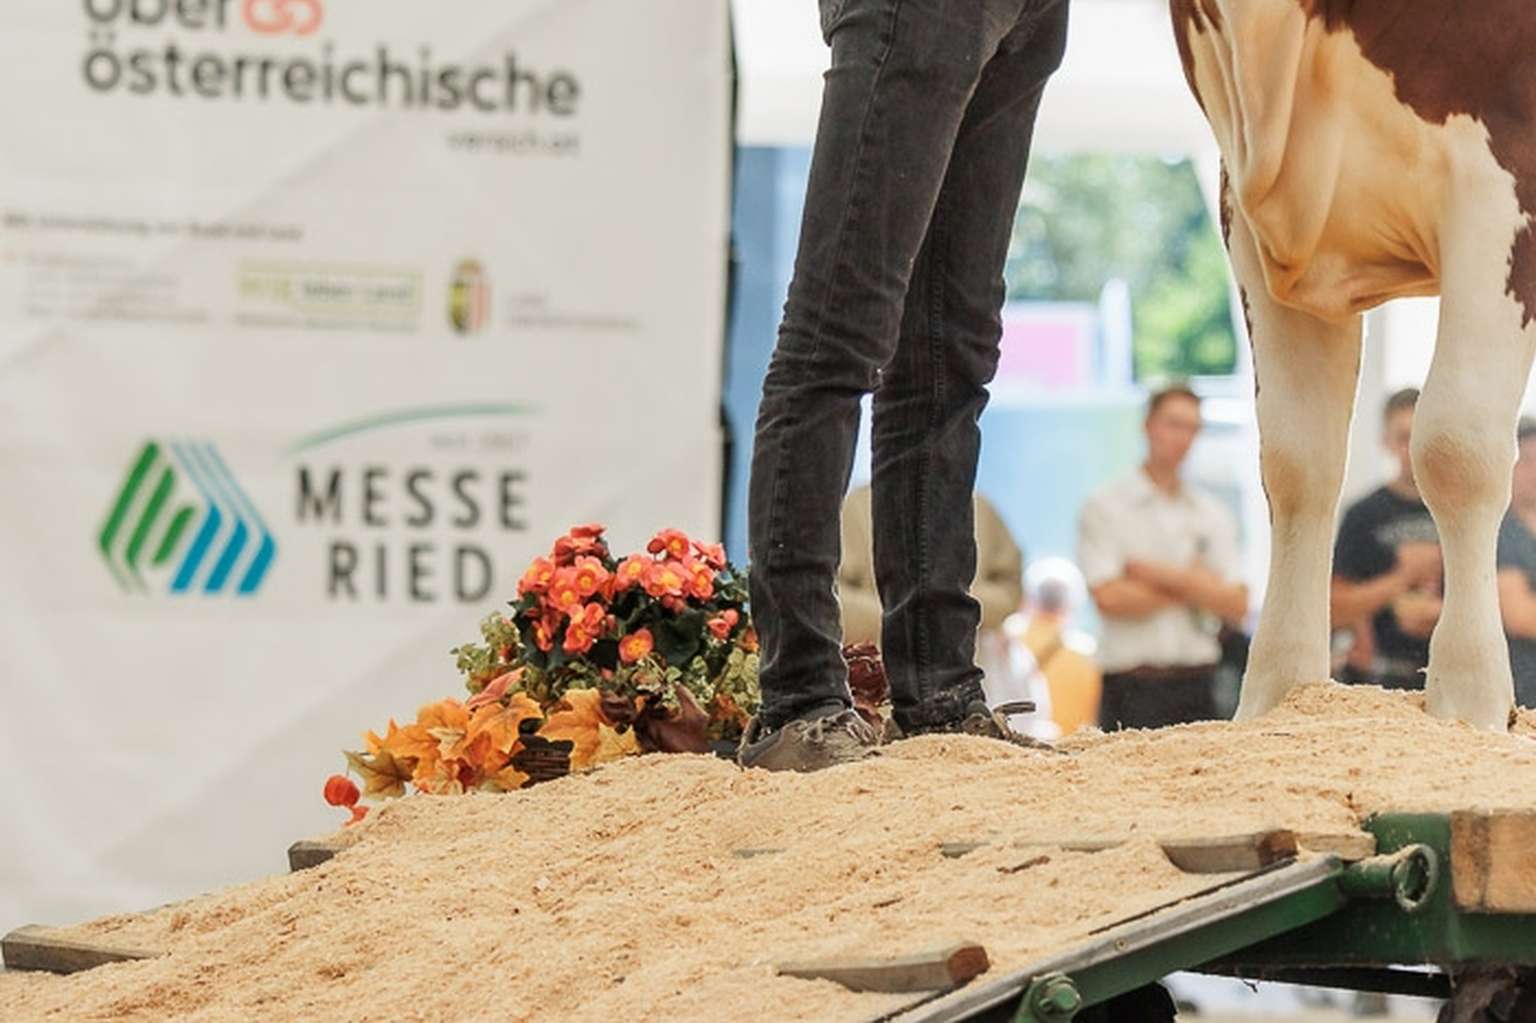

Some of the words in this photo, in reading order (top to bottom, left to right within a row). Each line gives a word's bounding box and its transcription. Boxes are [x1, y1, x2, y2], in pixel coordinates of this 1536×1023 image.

[82, 30, 581, 117] österreichische
[296, 466, 530, 531] MESSE
[328, 542, 496, 604] RIED
